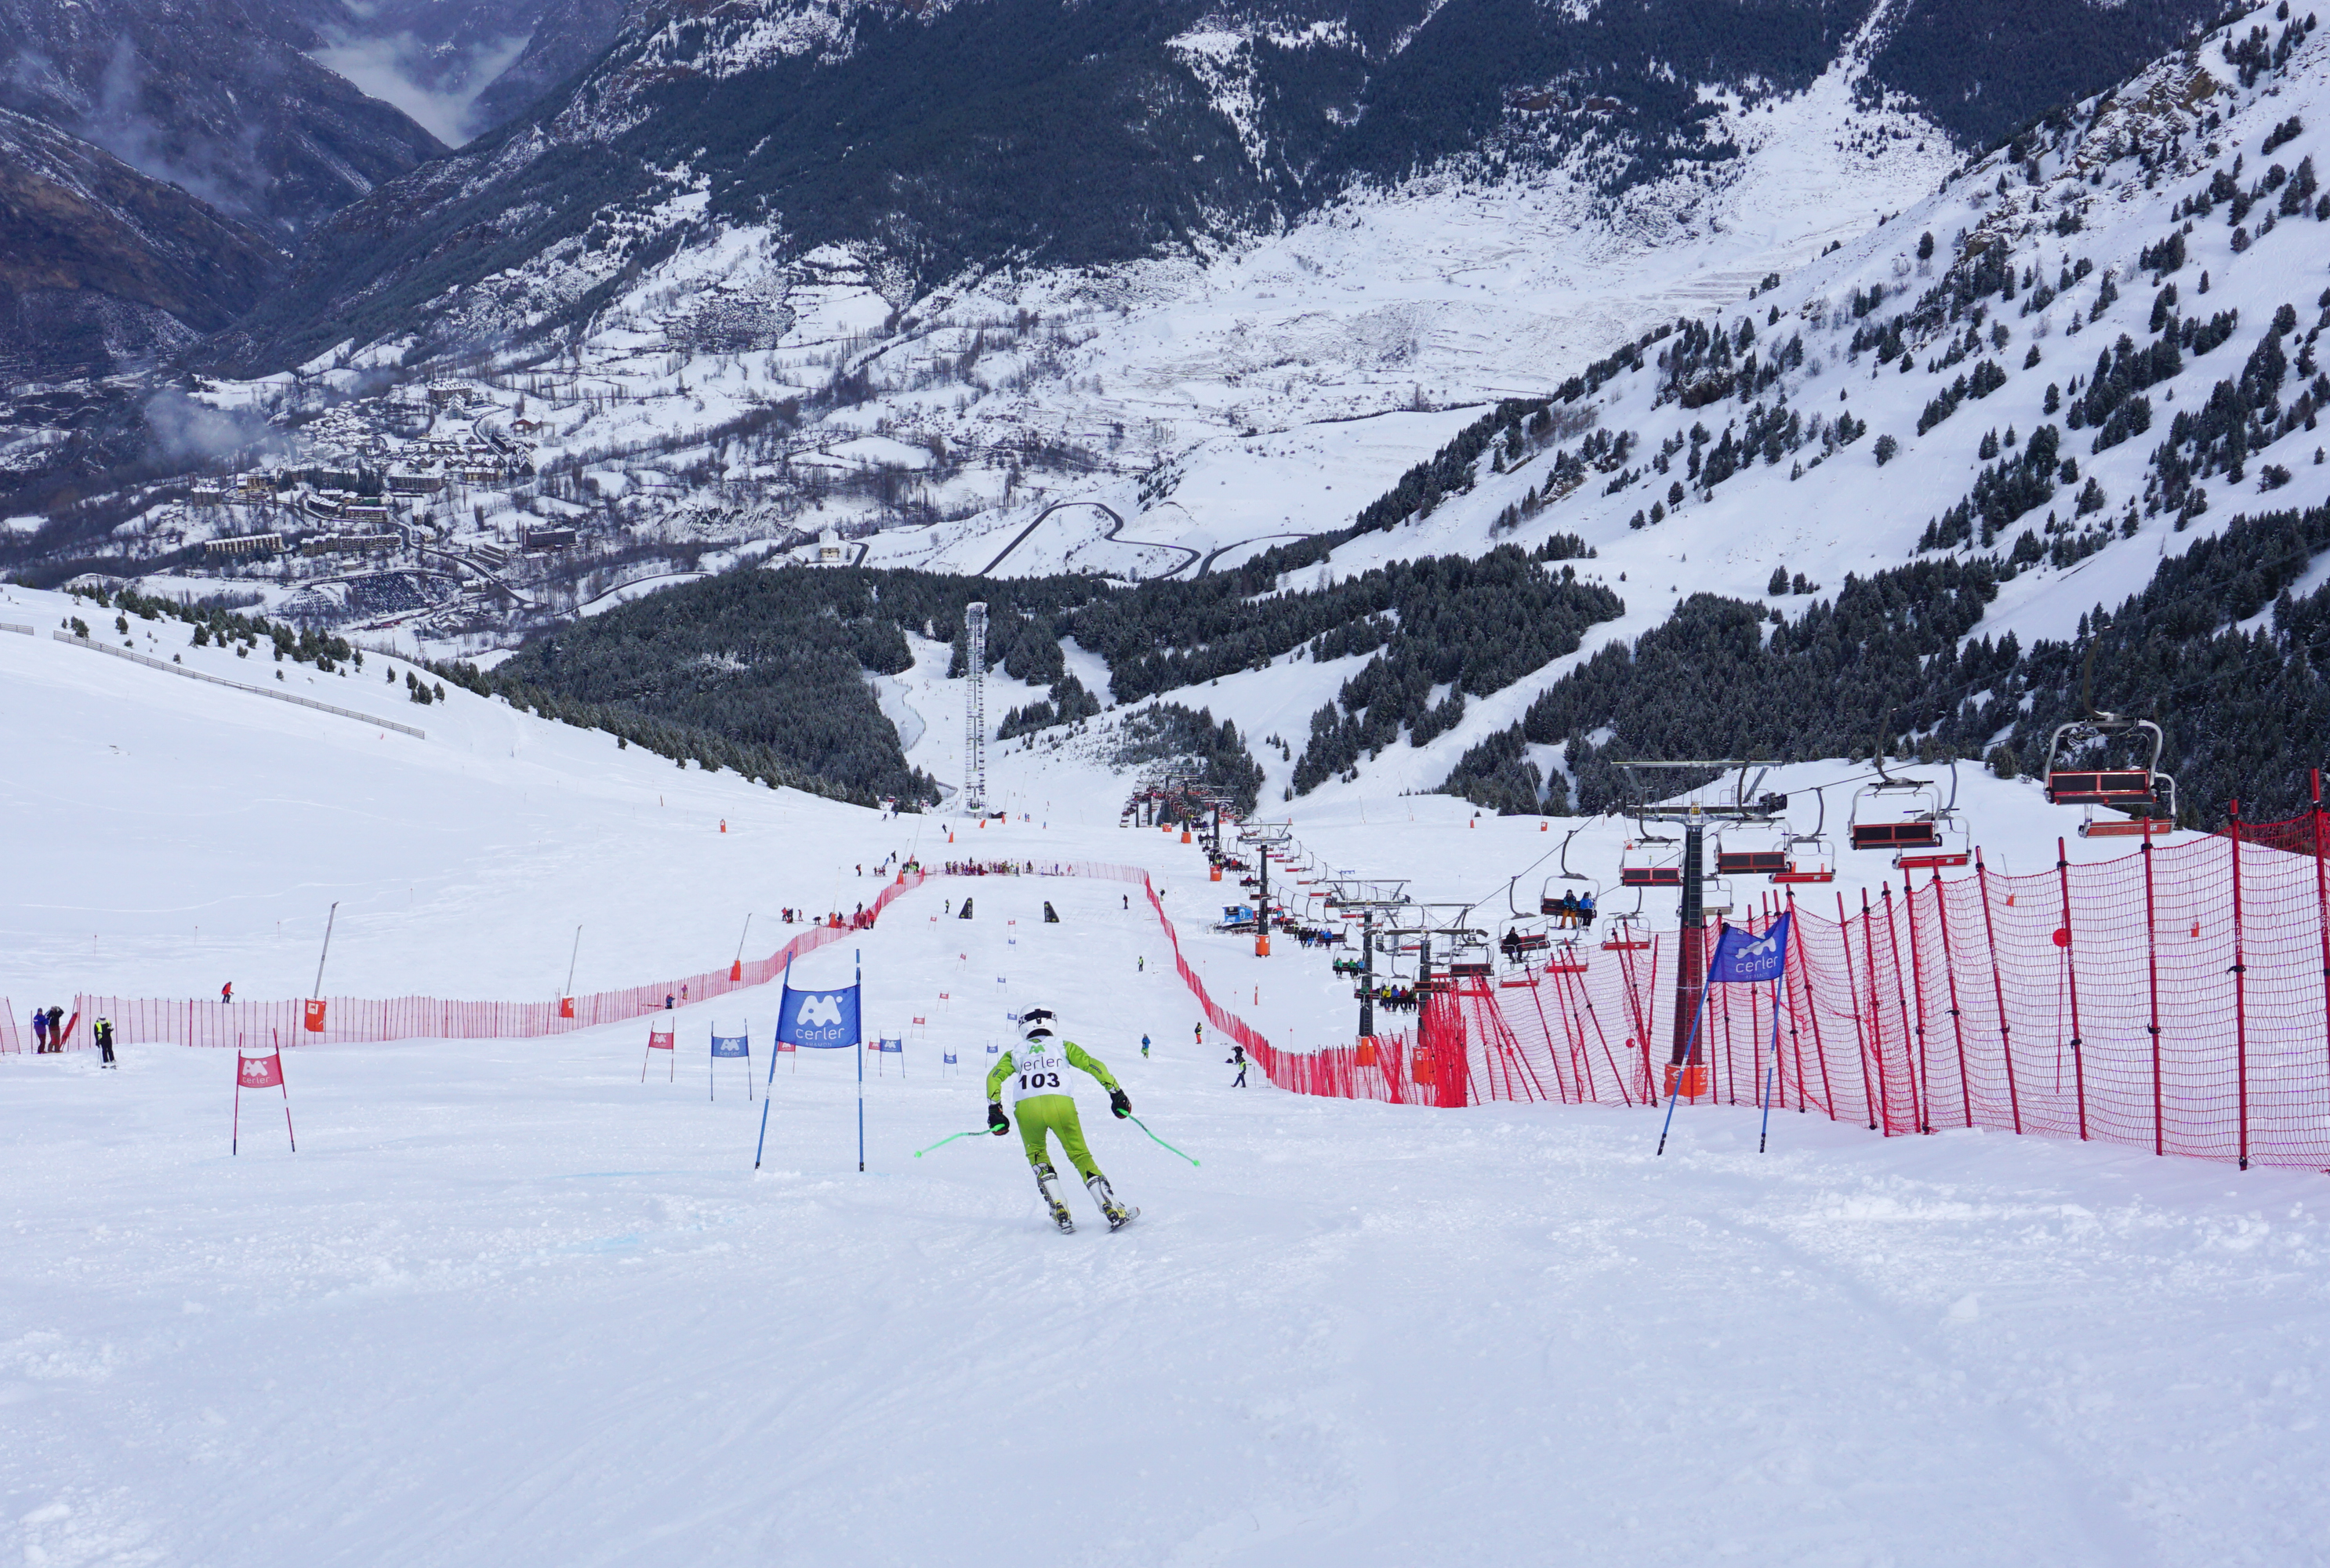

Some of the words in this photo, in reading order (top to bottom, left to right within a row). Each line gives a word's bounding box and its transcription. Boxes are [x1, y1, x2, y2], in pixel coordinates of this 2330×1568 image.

[1736, 956, 1778, 973] cerler
[796, 1027, 845, 1040] cerler
[1022, 1056, 1063, 1071] erler
[1018, 1073, 1060, 1090] 103
